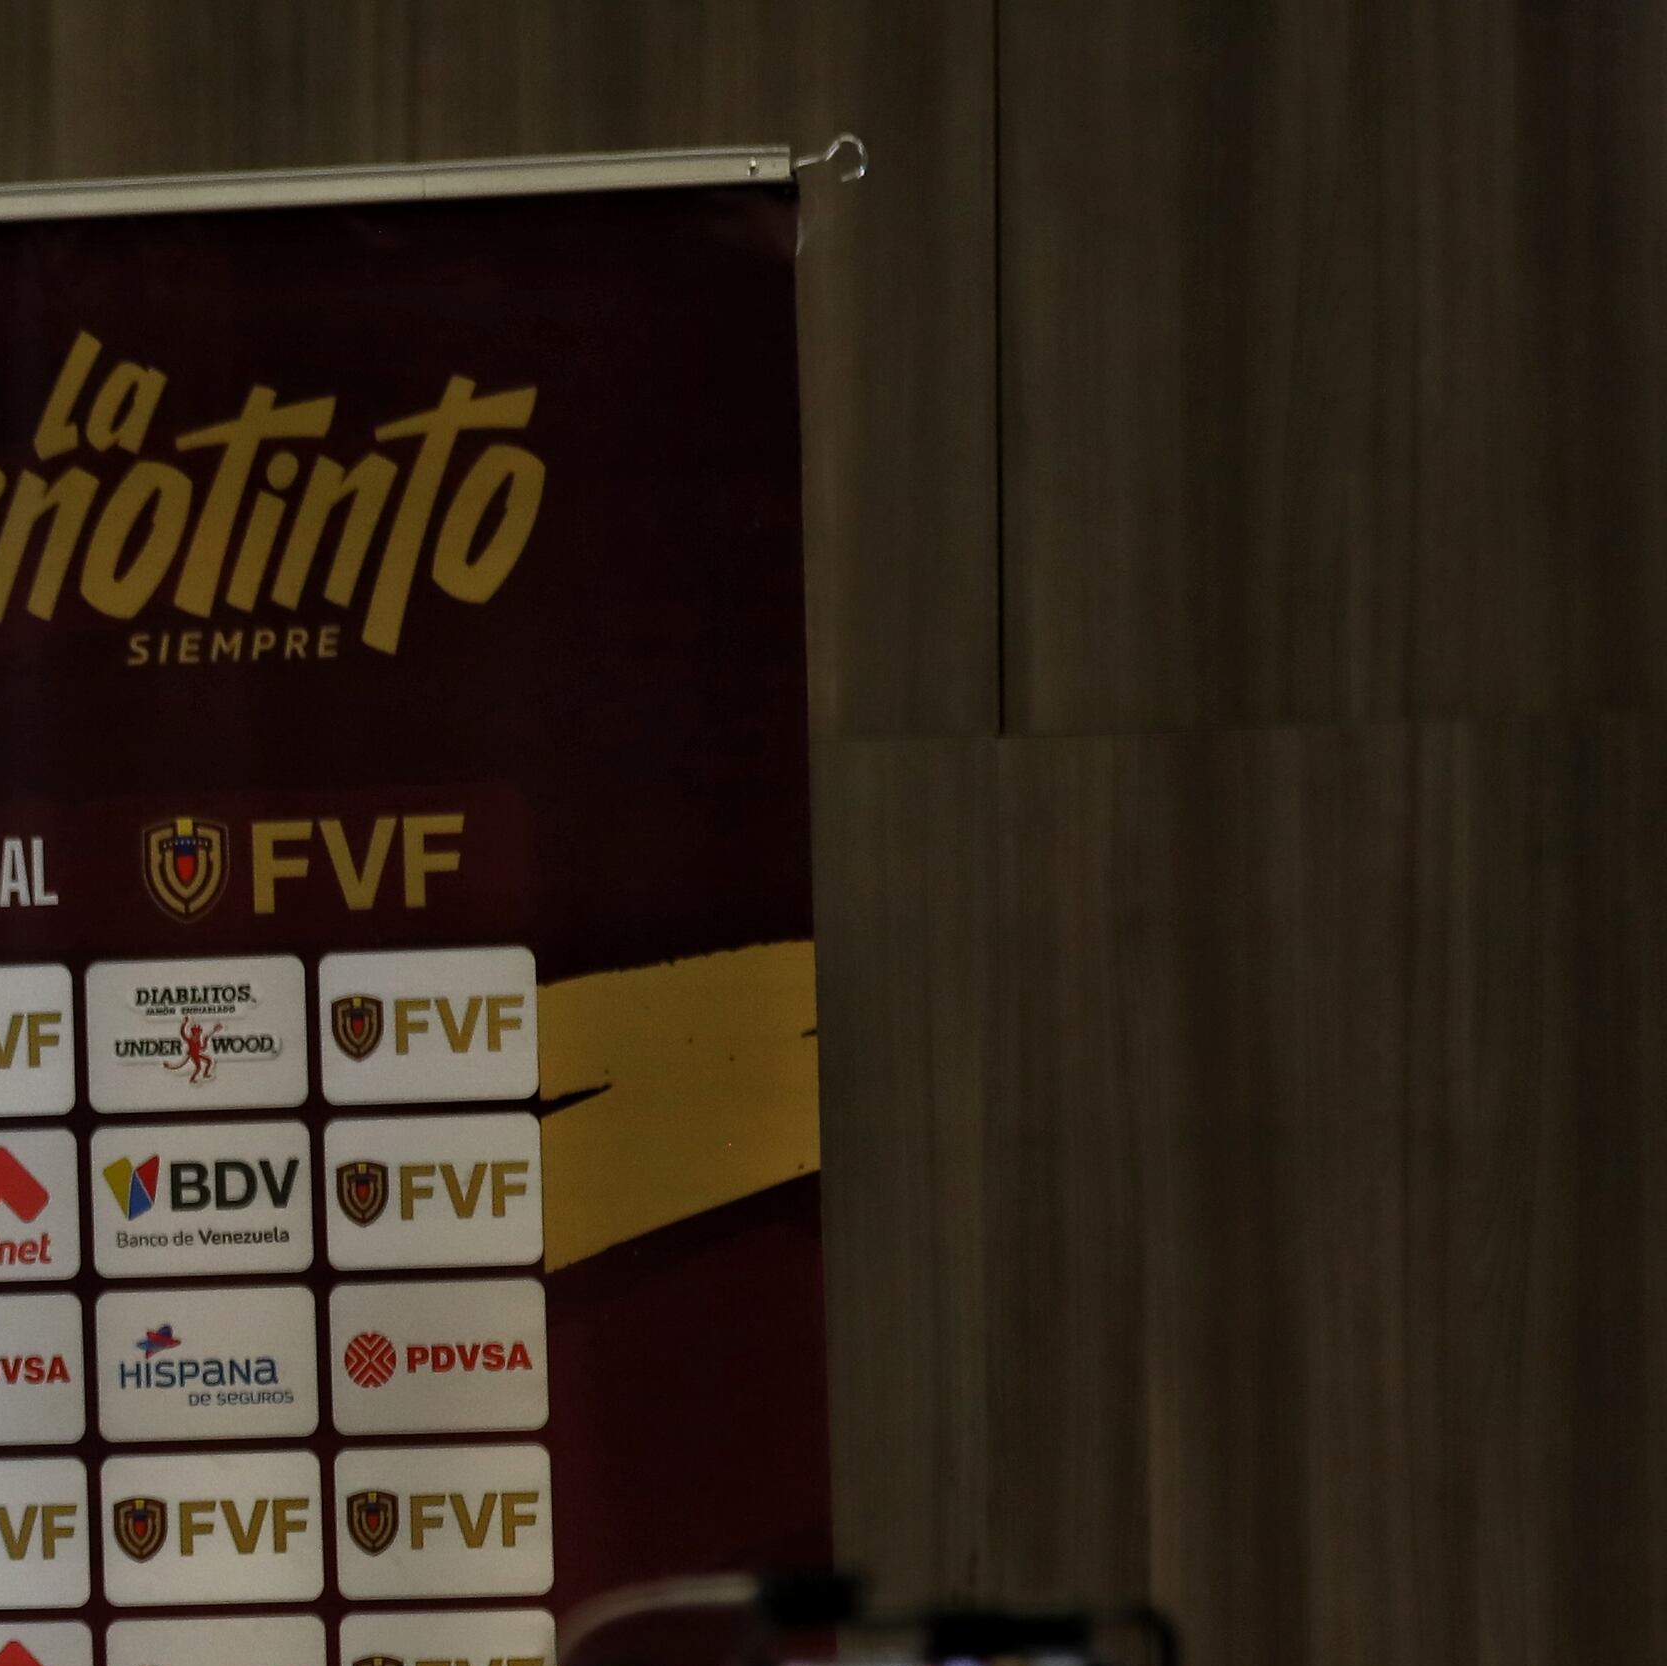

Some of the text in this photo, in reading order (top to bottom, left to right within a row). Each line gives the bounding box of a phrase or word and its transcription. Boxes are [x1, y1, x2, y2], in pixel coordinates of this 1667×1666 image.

[33, 328, 169, 462] La
[128, 626, 339, 665] SIEMPRE
[251, 813, 464, 913] FVF
[135, 984, 251, 1006] DIABLITOS
[394, 994, 524, 1055] FVF
[170, 1158, 299, 1211] BDV
[398, 1161, 529, 1221] FVF
[115, 1225, 290, 1250] Banco de Venezuela
[406, 1342, 532, 1373] PDVSA
[178, 1496, 310, 1556] FVF
[409, 1491, 539, 1550] FVF
